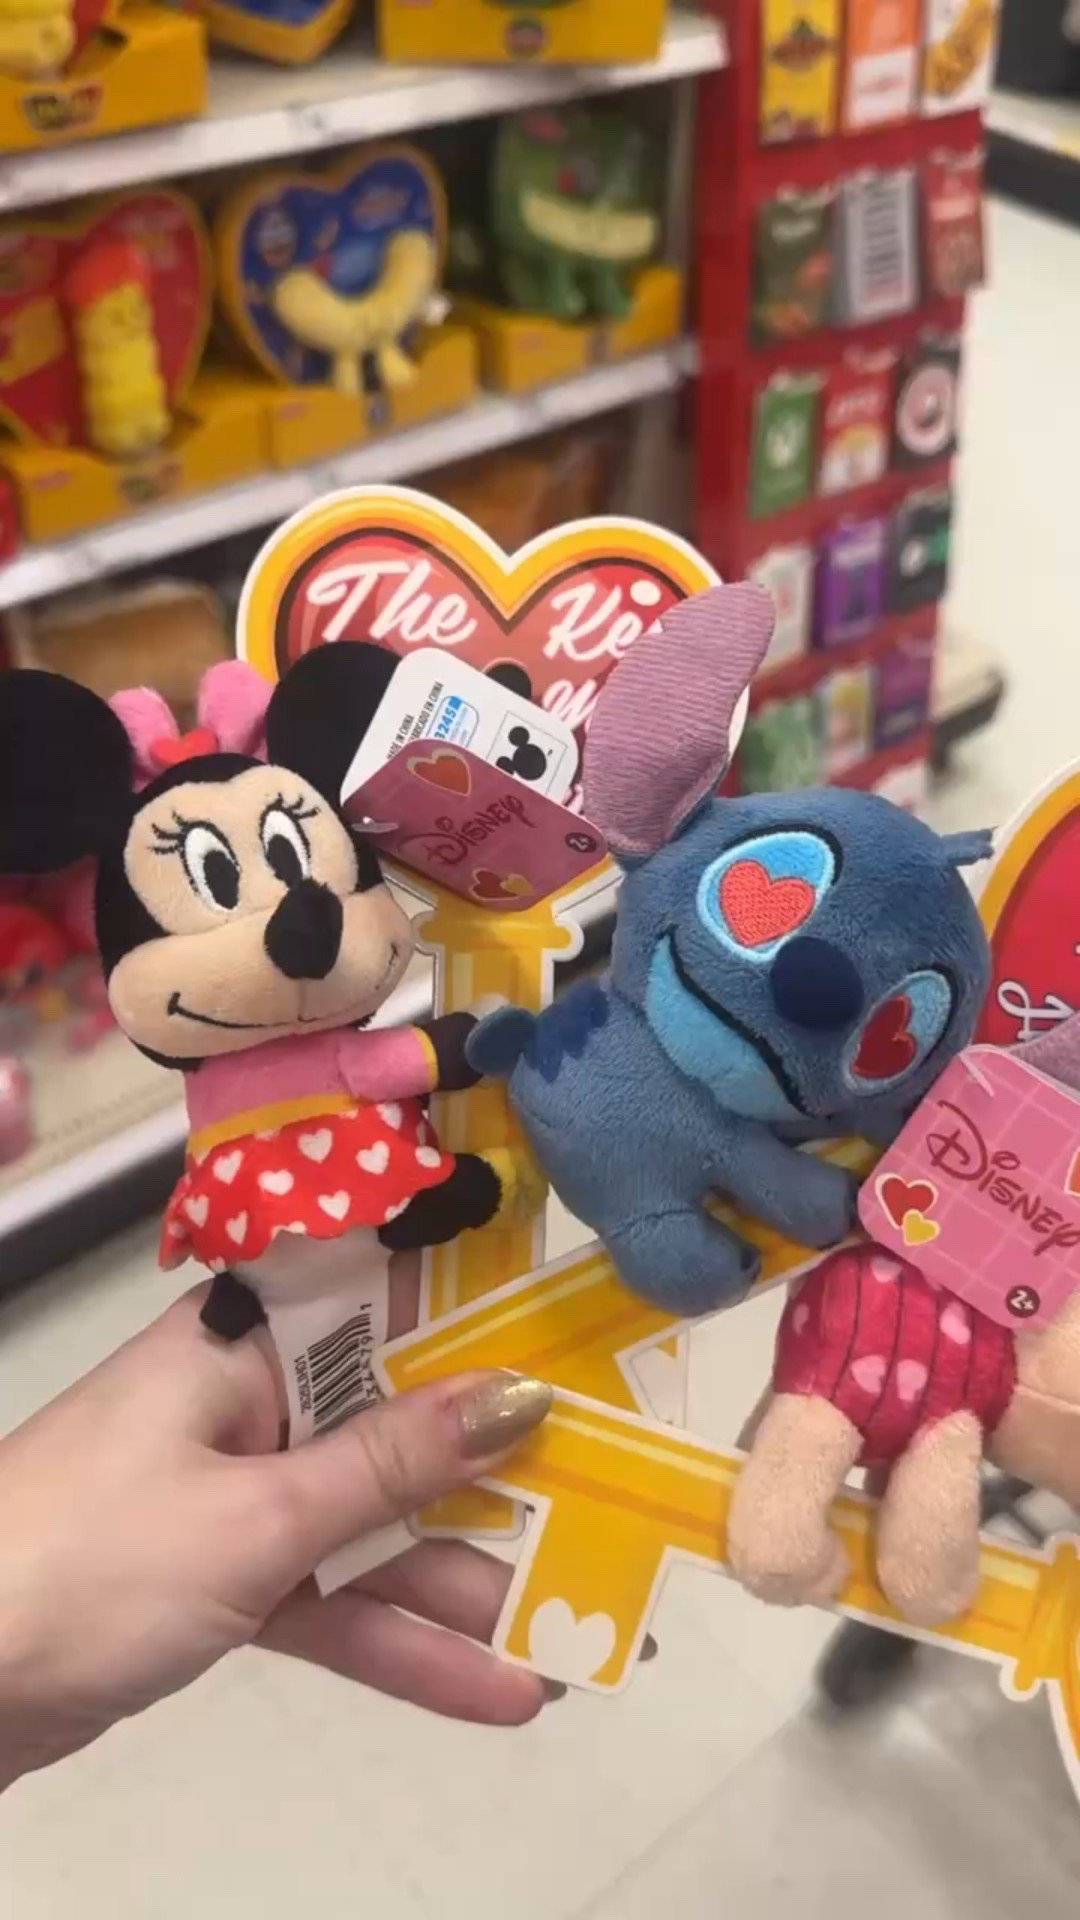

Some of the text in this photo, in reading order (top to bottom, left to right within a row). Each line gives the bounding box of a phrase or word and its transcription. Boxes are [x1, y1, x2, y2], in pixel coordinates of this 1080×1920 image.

[306, 559, 478, 643] The
[428, 682, 443, 702] CHINA
[400, 714, 414, 735] CHINA
[1011, 1289, 1034, 1310] 2+
